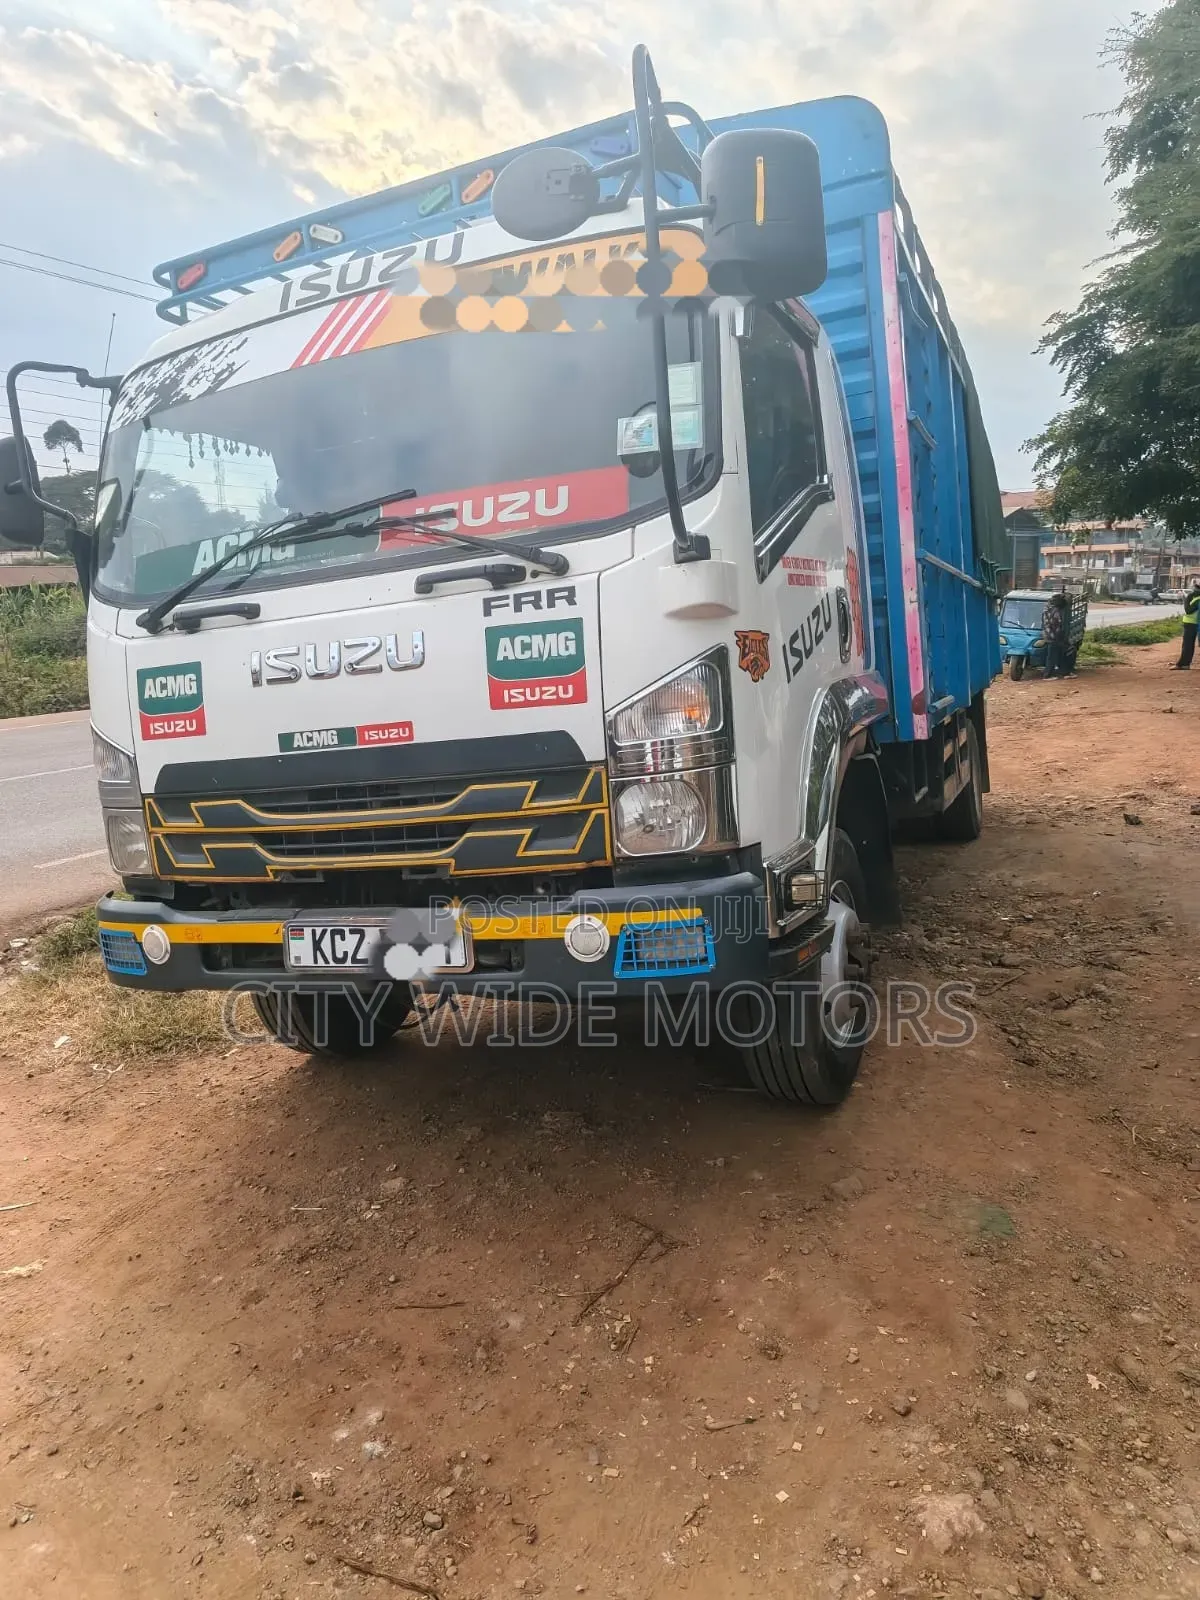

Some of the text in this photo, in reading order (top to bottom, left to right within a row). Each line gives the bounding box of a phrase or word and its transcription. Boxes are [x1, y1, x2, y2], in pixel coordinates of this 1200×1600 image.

[279, 231, 465, 313] ISUZU
[414, 485, 569, 536] ISUZU
[482, 586, 578, 617] FRR
[496, 631, 577, 662] ACMG
[782, 593, 832, 684] ISUZU
[251, 630, 425, 687] ISUZU
[144, 673, 198, 700] ACMG
[503, 684, 574, 704] ISUZU
[149, 718, 197, 735] ISUZU
[293, 727, 410, 749] ACMG ISUZU
[311, 928, 369, 965] KCZ
